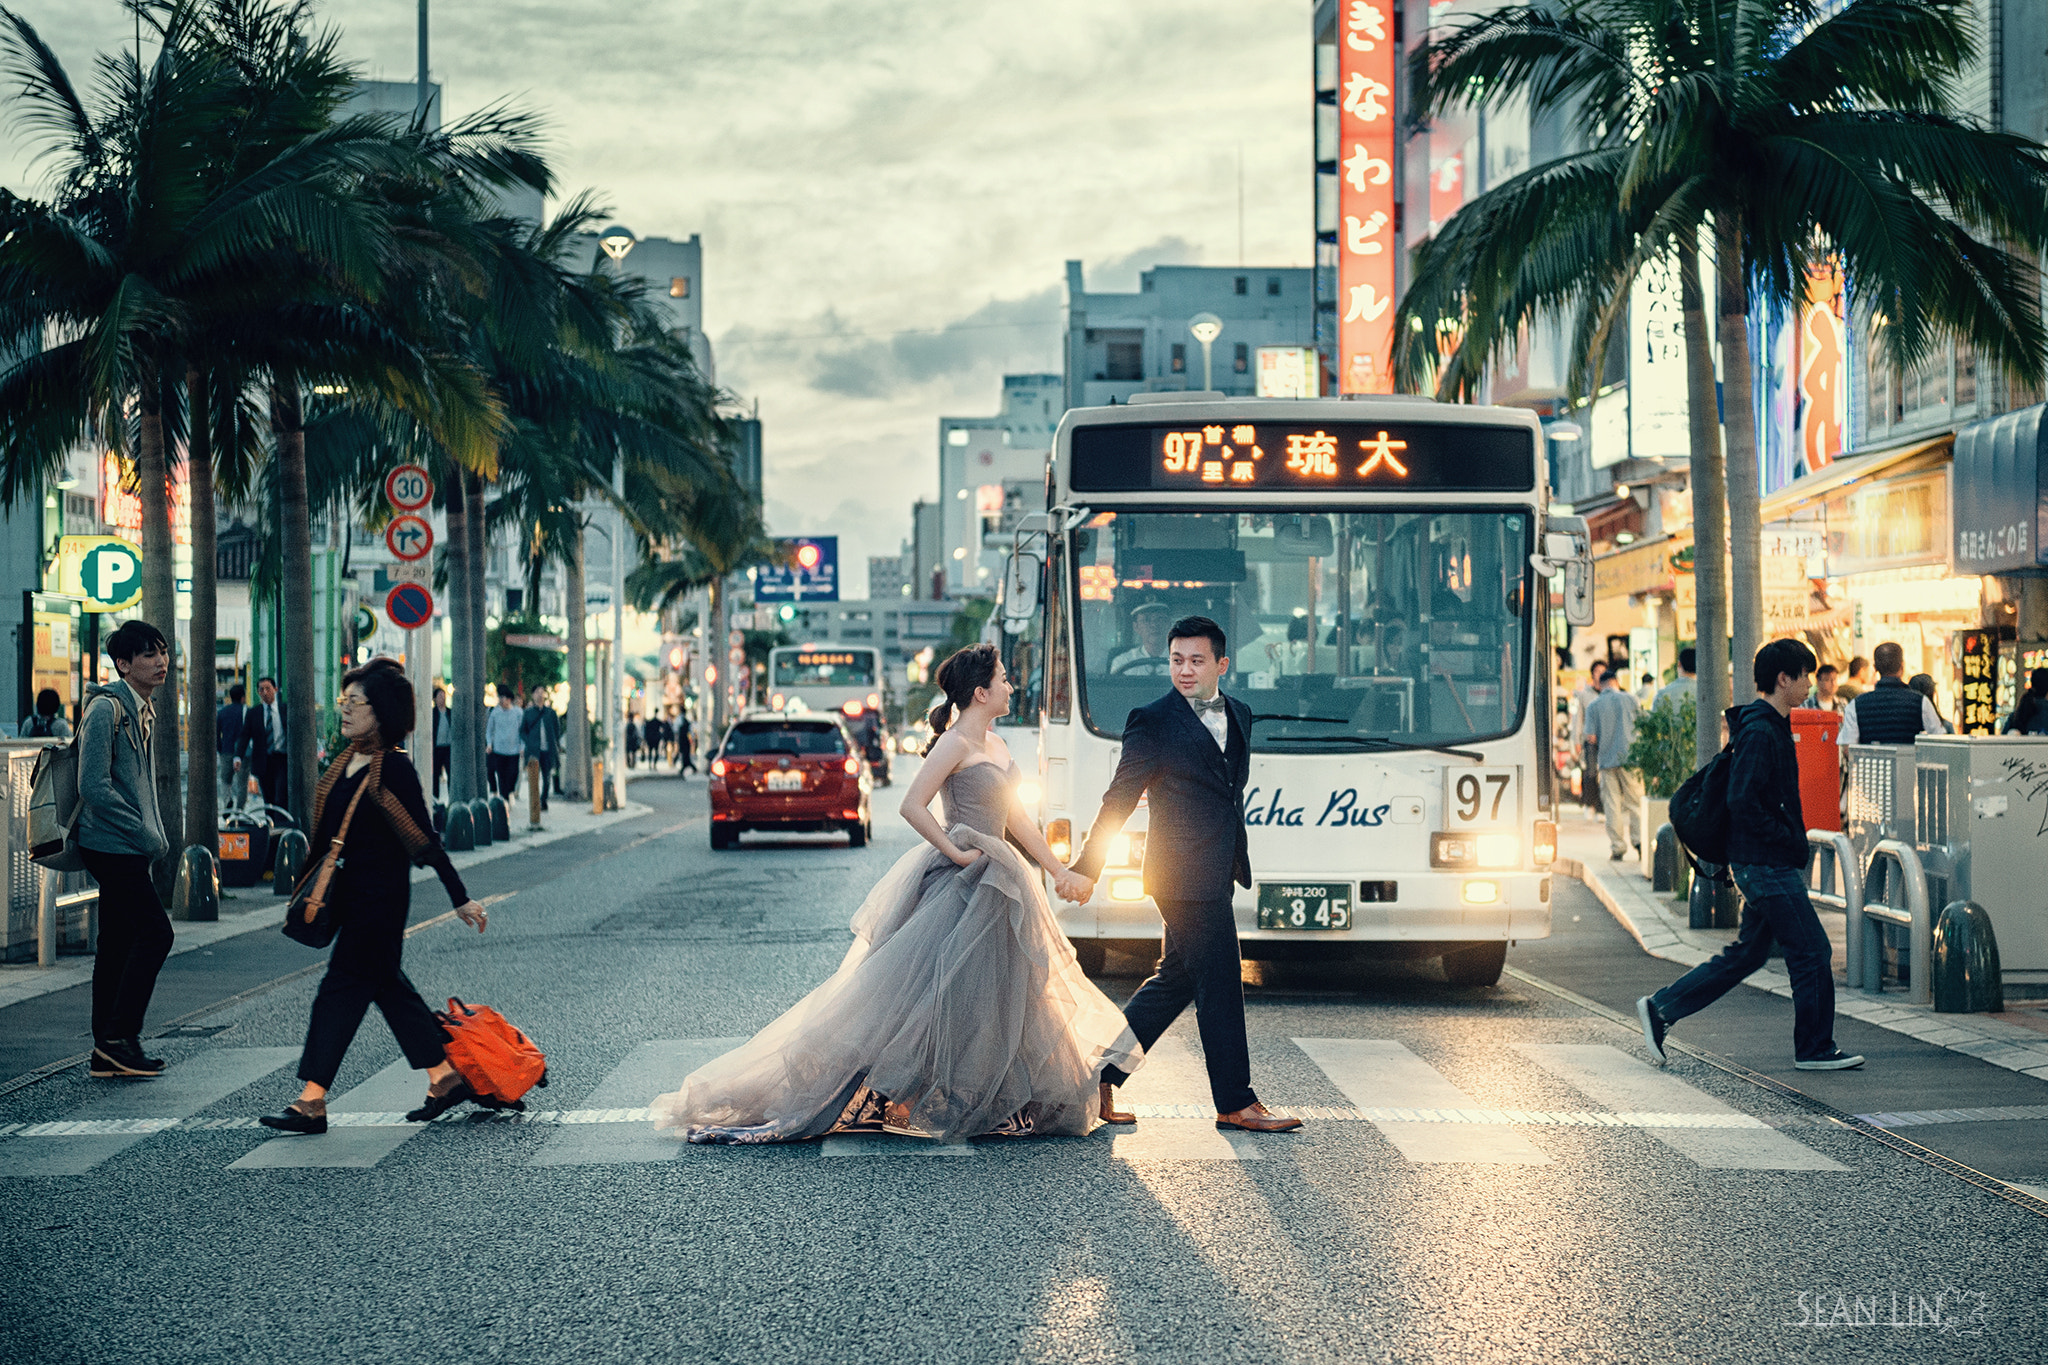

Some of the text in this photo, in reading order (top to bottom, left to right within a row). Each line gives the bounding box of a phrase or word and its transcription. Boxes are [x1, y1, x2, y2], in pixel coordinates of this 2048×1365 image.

[1164, 431, 1203, 472] 97
[397, 476, 423, 499] 30
[97, 550, 135, 600] P
[1315, 787, 1391, 827] Bus
[1456, 773, 1512, 822] 97
